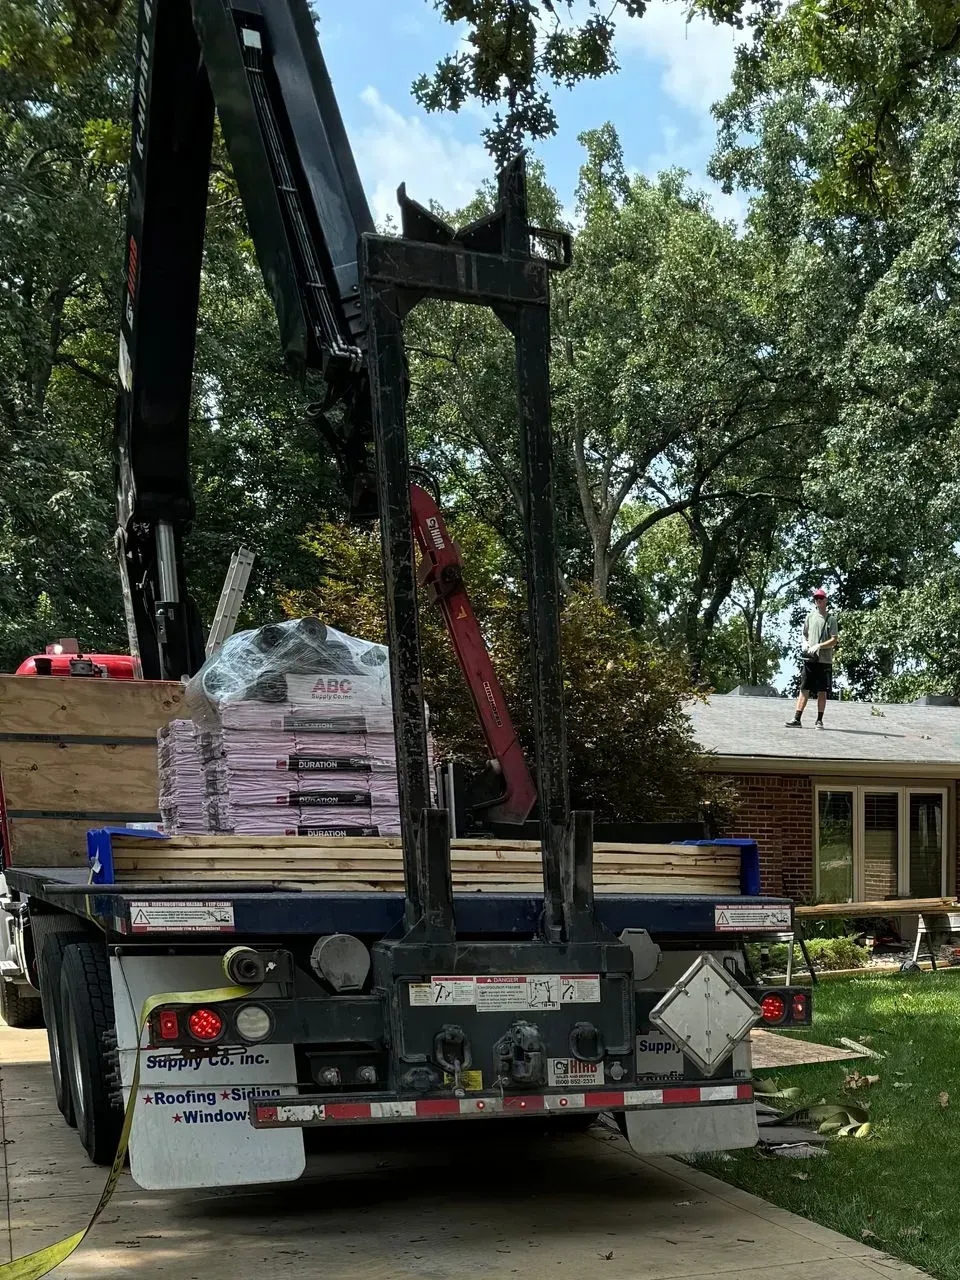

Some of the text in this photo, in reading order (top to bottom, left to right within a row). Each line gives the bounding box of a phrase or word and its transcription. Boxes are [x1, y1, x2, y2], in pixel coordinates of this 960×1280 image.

[311, 678, 352, 694] ABC
[299, 761, 338, 769] DURATION
[154, 1091, 217, 1106] Roofing
